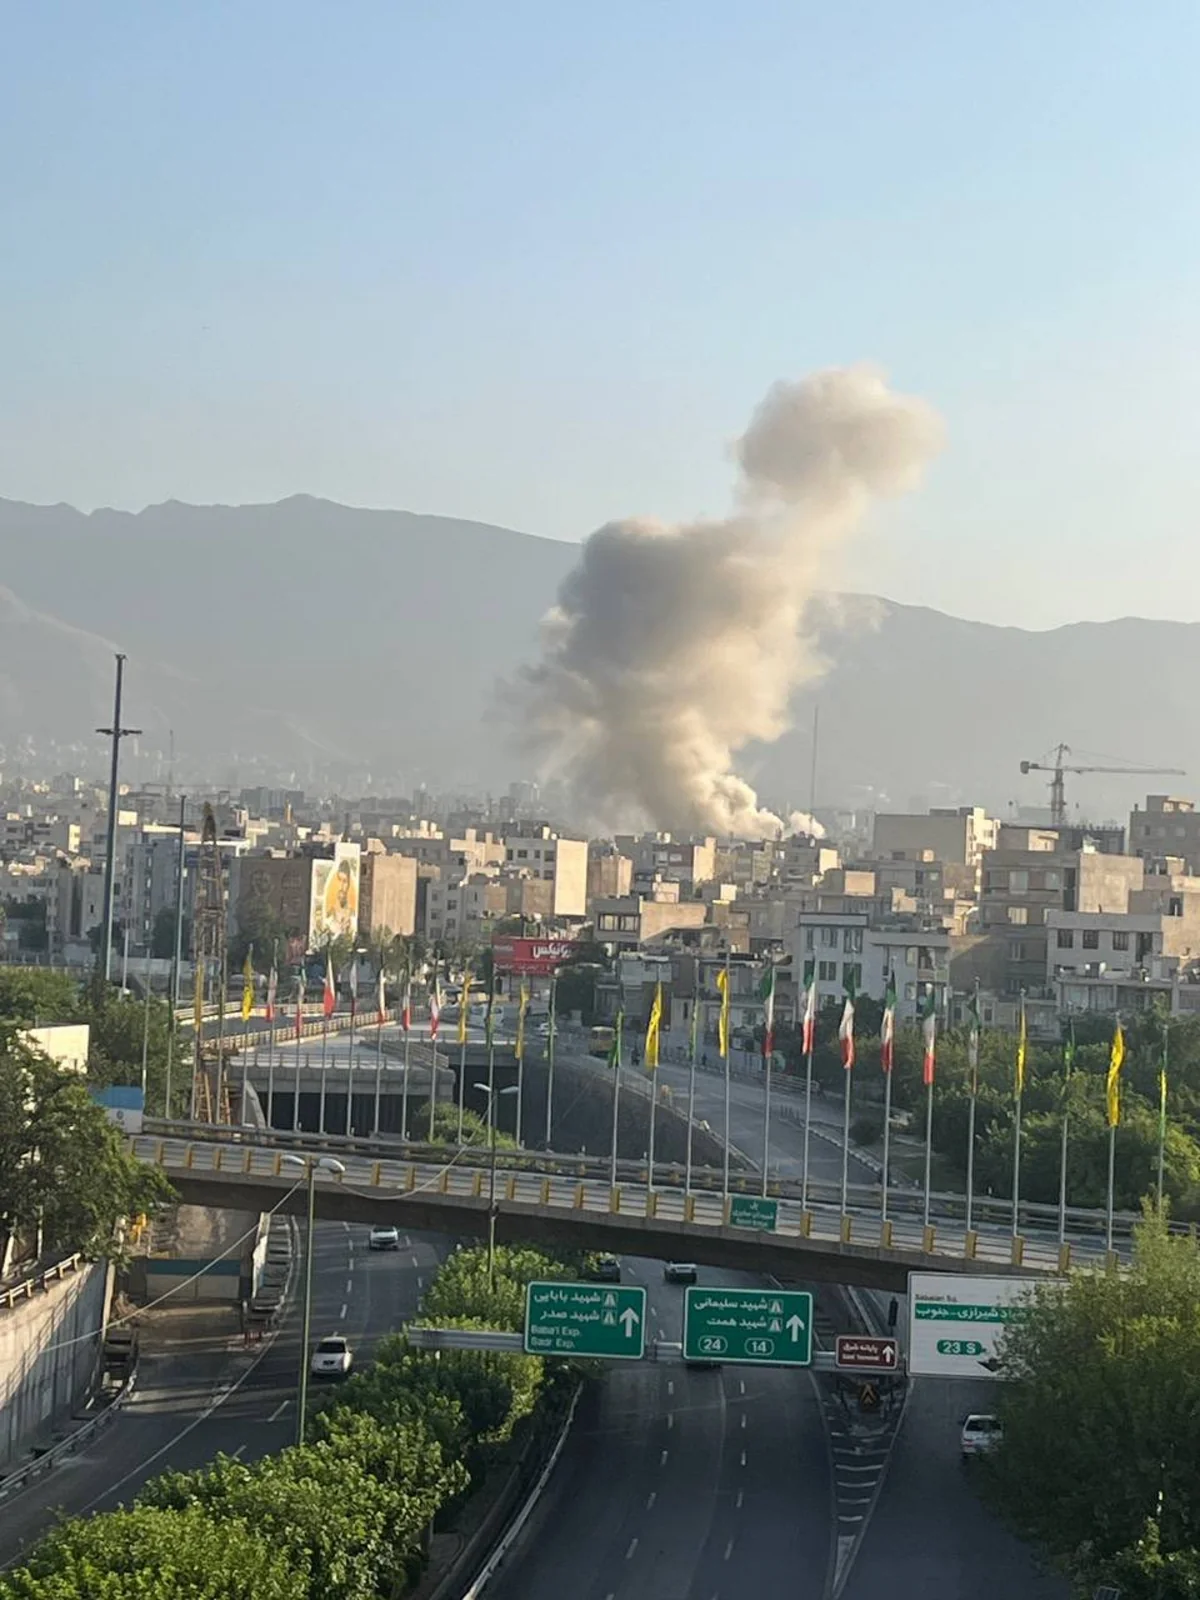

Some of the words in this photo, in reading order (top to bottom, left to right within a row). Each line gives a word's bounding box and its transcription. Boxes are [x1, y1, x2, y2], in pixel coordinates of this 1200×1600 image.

[534, 1290, 568, 1303] بابایی
[570, 1291, 601, 1304] شهید
[694, 1297, 738, 1310] سلیمانی
[739, 1297, 768, 1311] شهید
[540, 1310, 567, 1320] صدر
[570, 1310, 600, 1322] شهید
[916, 1307, 949, 1319] جنوب
[957, 1306, 999, 1319] شیرازی
[706, 1317, 737, 1326] همت
[739, 1316, 767, 1329] شهید
[703, 1339, 721, 1350] 24
[751, 1341, 767, 1353] 14
[943, 1342, 961, 1354] 23
[966, 1343, 976, 1354] S
